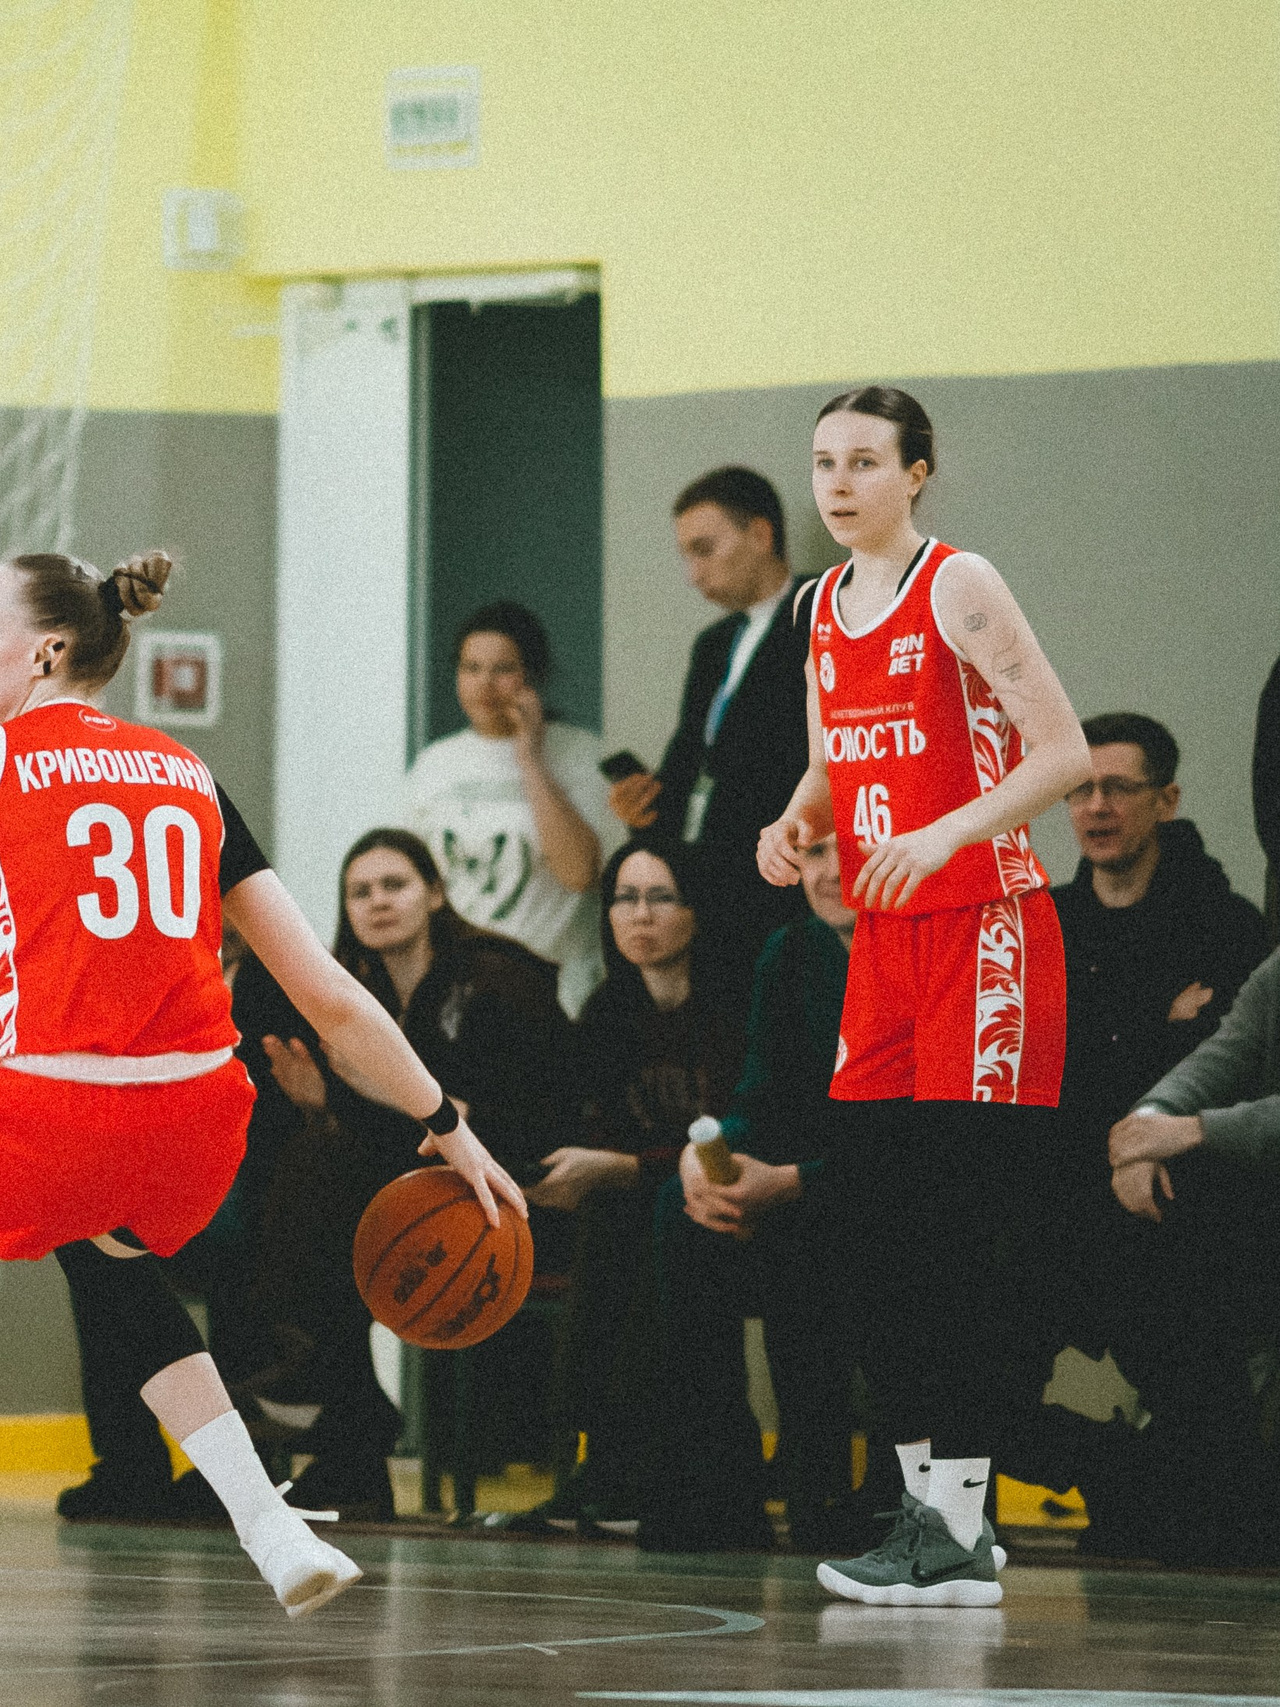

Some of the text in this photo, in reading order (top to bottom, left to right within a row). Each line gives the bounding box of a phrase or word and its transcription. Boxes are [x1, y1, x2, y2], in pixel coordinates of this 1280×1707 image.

[14, 747, 214, 803] КРИВОШЕИНА
[853, 783, 892, 846] 46
[66, 803, 201, 939] 30
